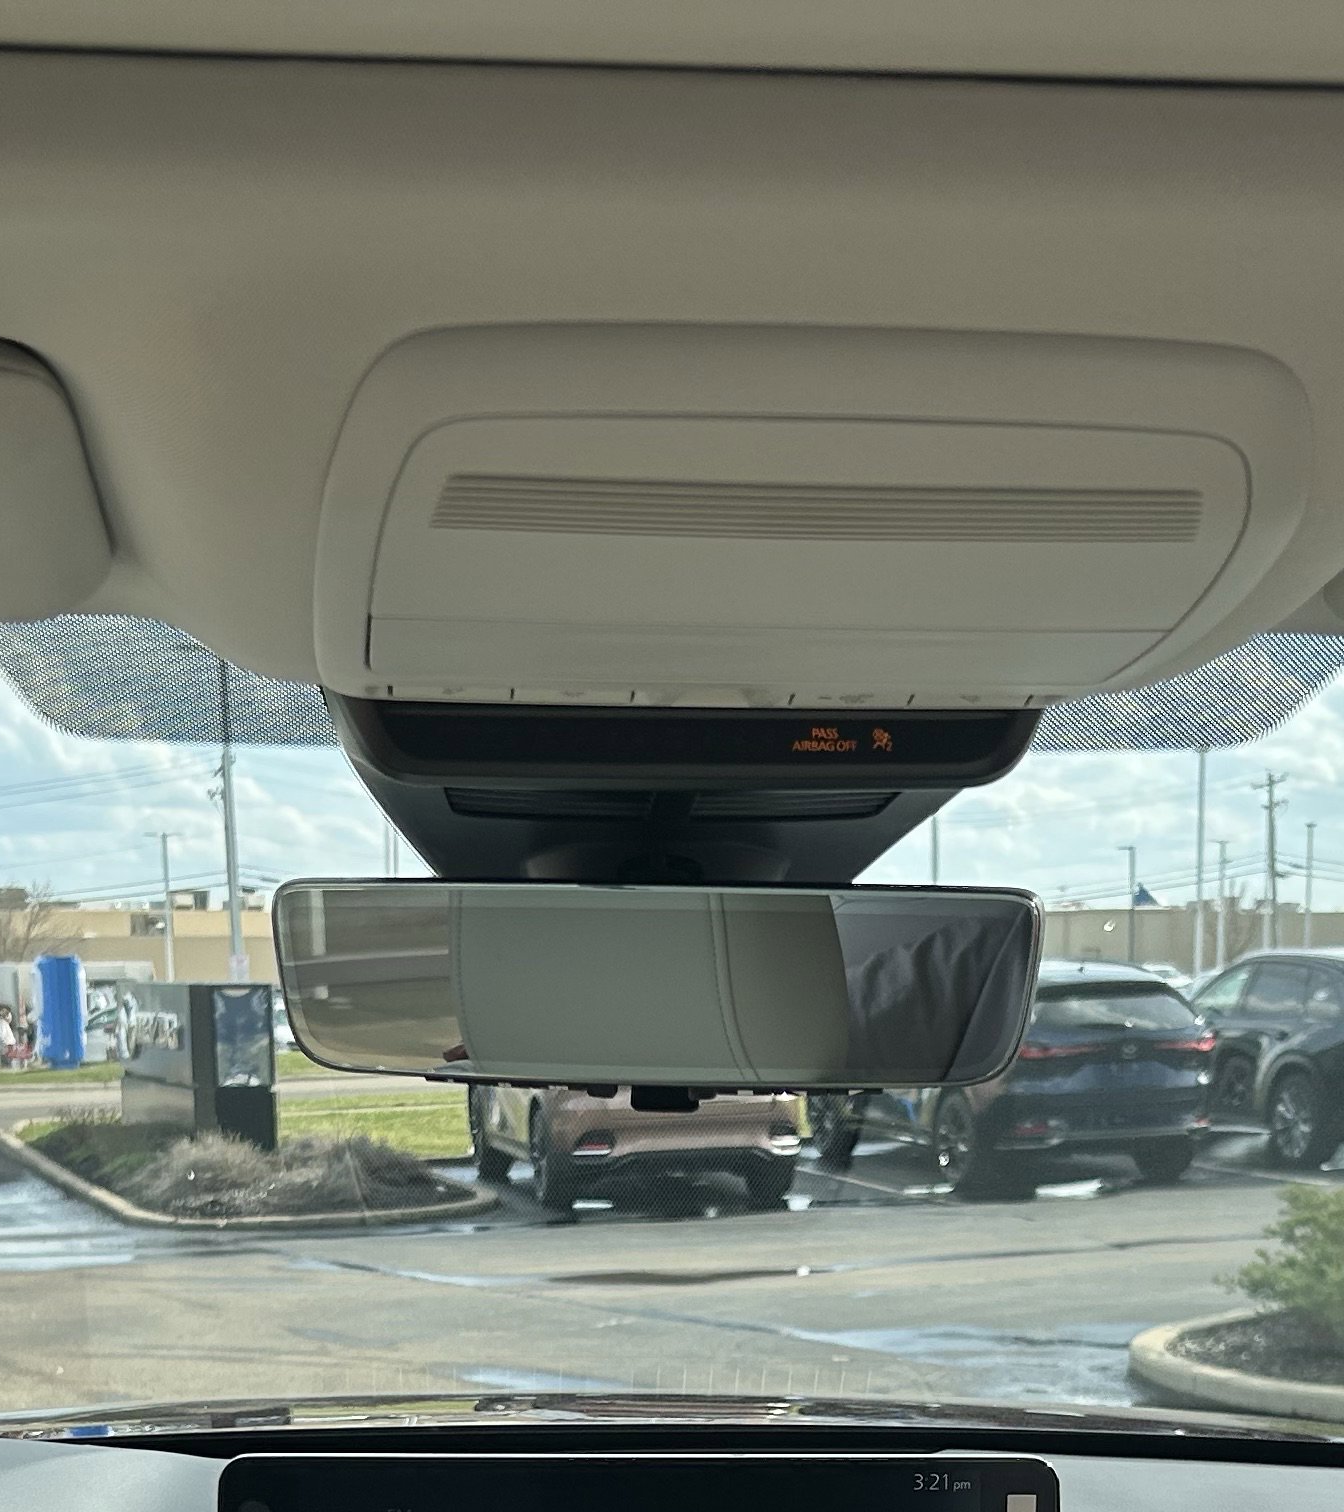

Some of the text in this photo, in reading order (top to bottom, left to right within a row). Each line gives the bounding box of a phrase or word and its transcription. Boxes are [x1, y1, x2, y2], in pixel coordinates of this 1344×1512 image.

[812, 728, 839, 739] PASS
[792, 740, 857, 752] AIRBAG OFF
[913, 1473, 971, 1492] 3:21 pm
